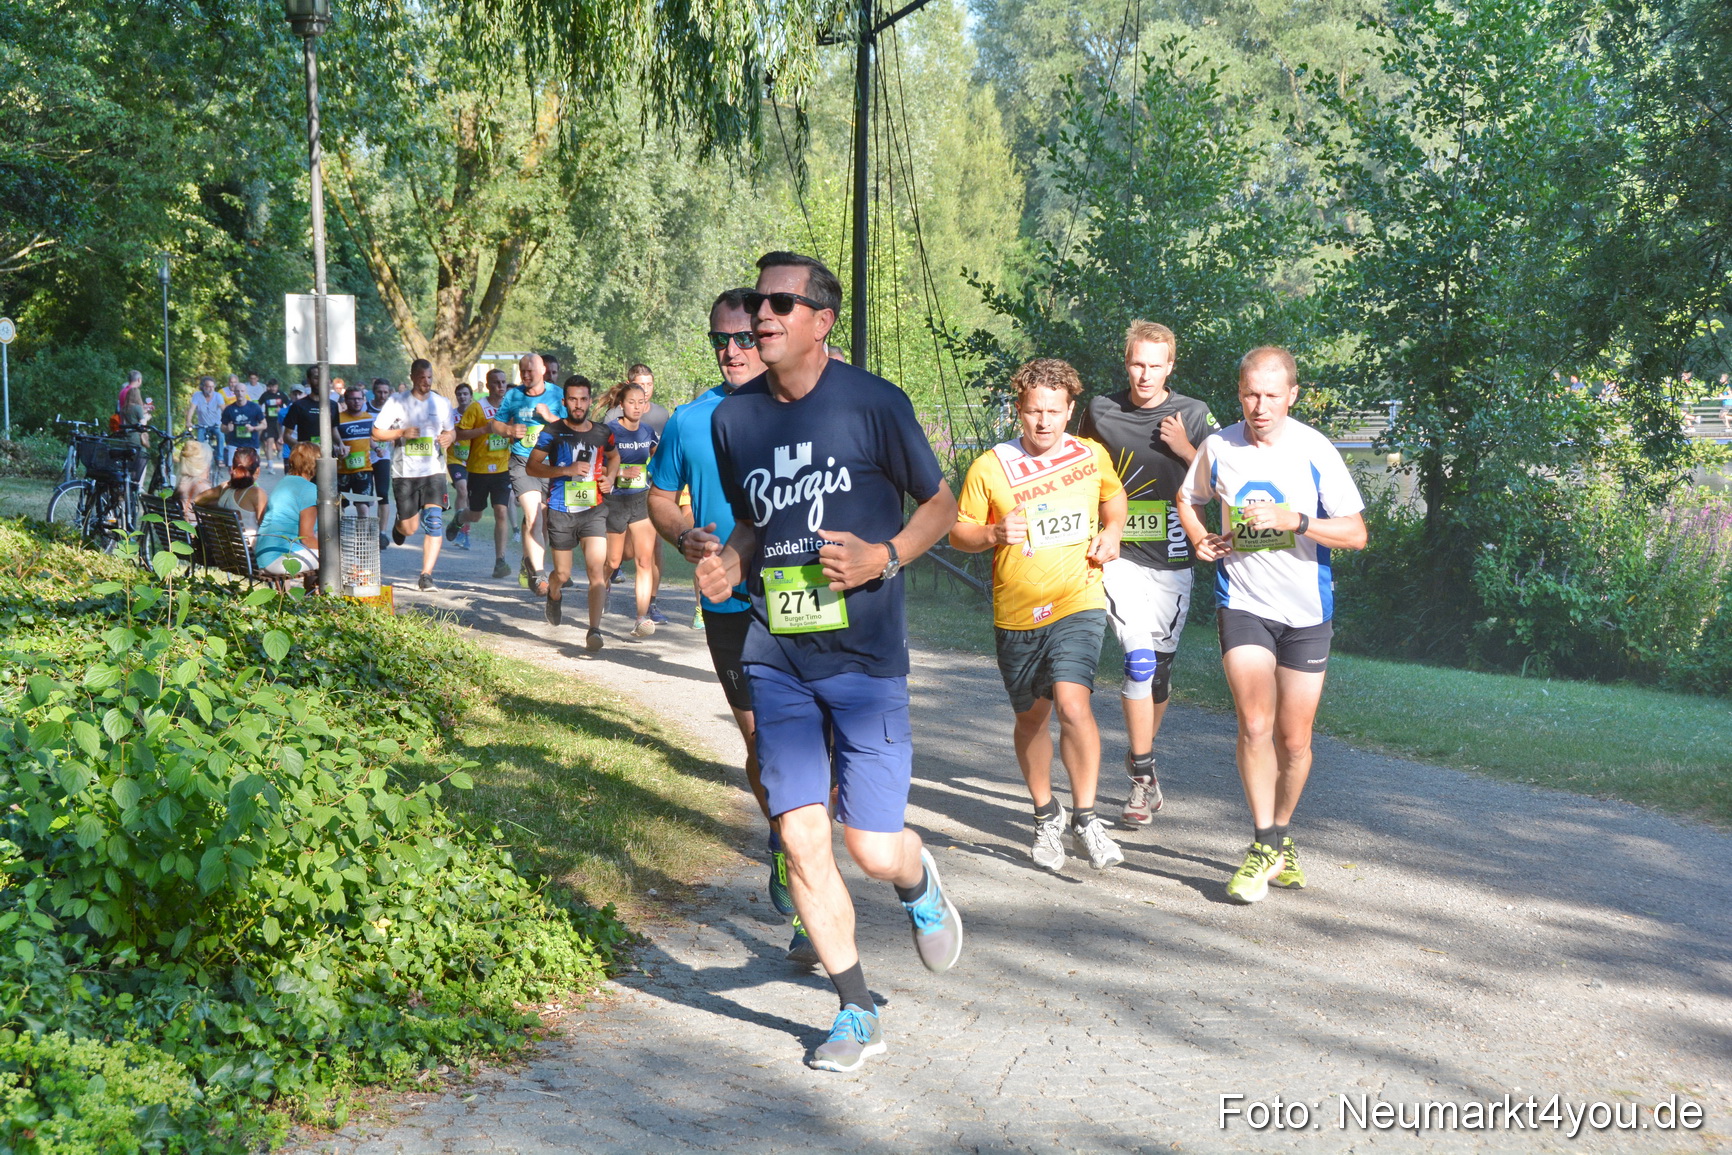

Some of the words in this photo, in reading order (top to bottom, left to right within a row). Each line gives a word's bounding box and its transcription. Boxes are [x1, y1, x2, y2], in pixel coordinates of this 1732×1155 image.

[526, 433, 539, 441] 78
[409, 443, 430, 451] 1380
[349, 457, 362, 465] 619
[575, 490, 588, 499] 46
[743, 456, 852, 532] Burgis
[1013, 480, 1058, 505] MAX
[1036, 512, 1082, 536] 1237
[764, 537, 843, 559] nödellie
[778, 588, 821, 615] 271
[784, 615, 805, 623] Burger
